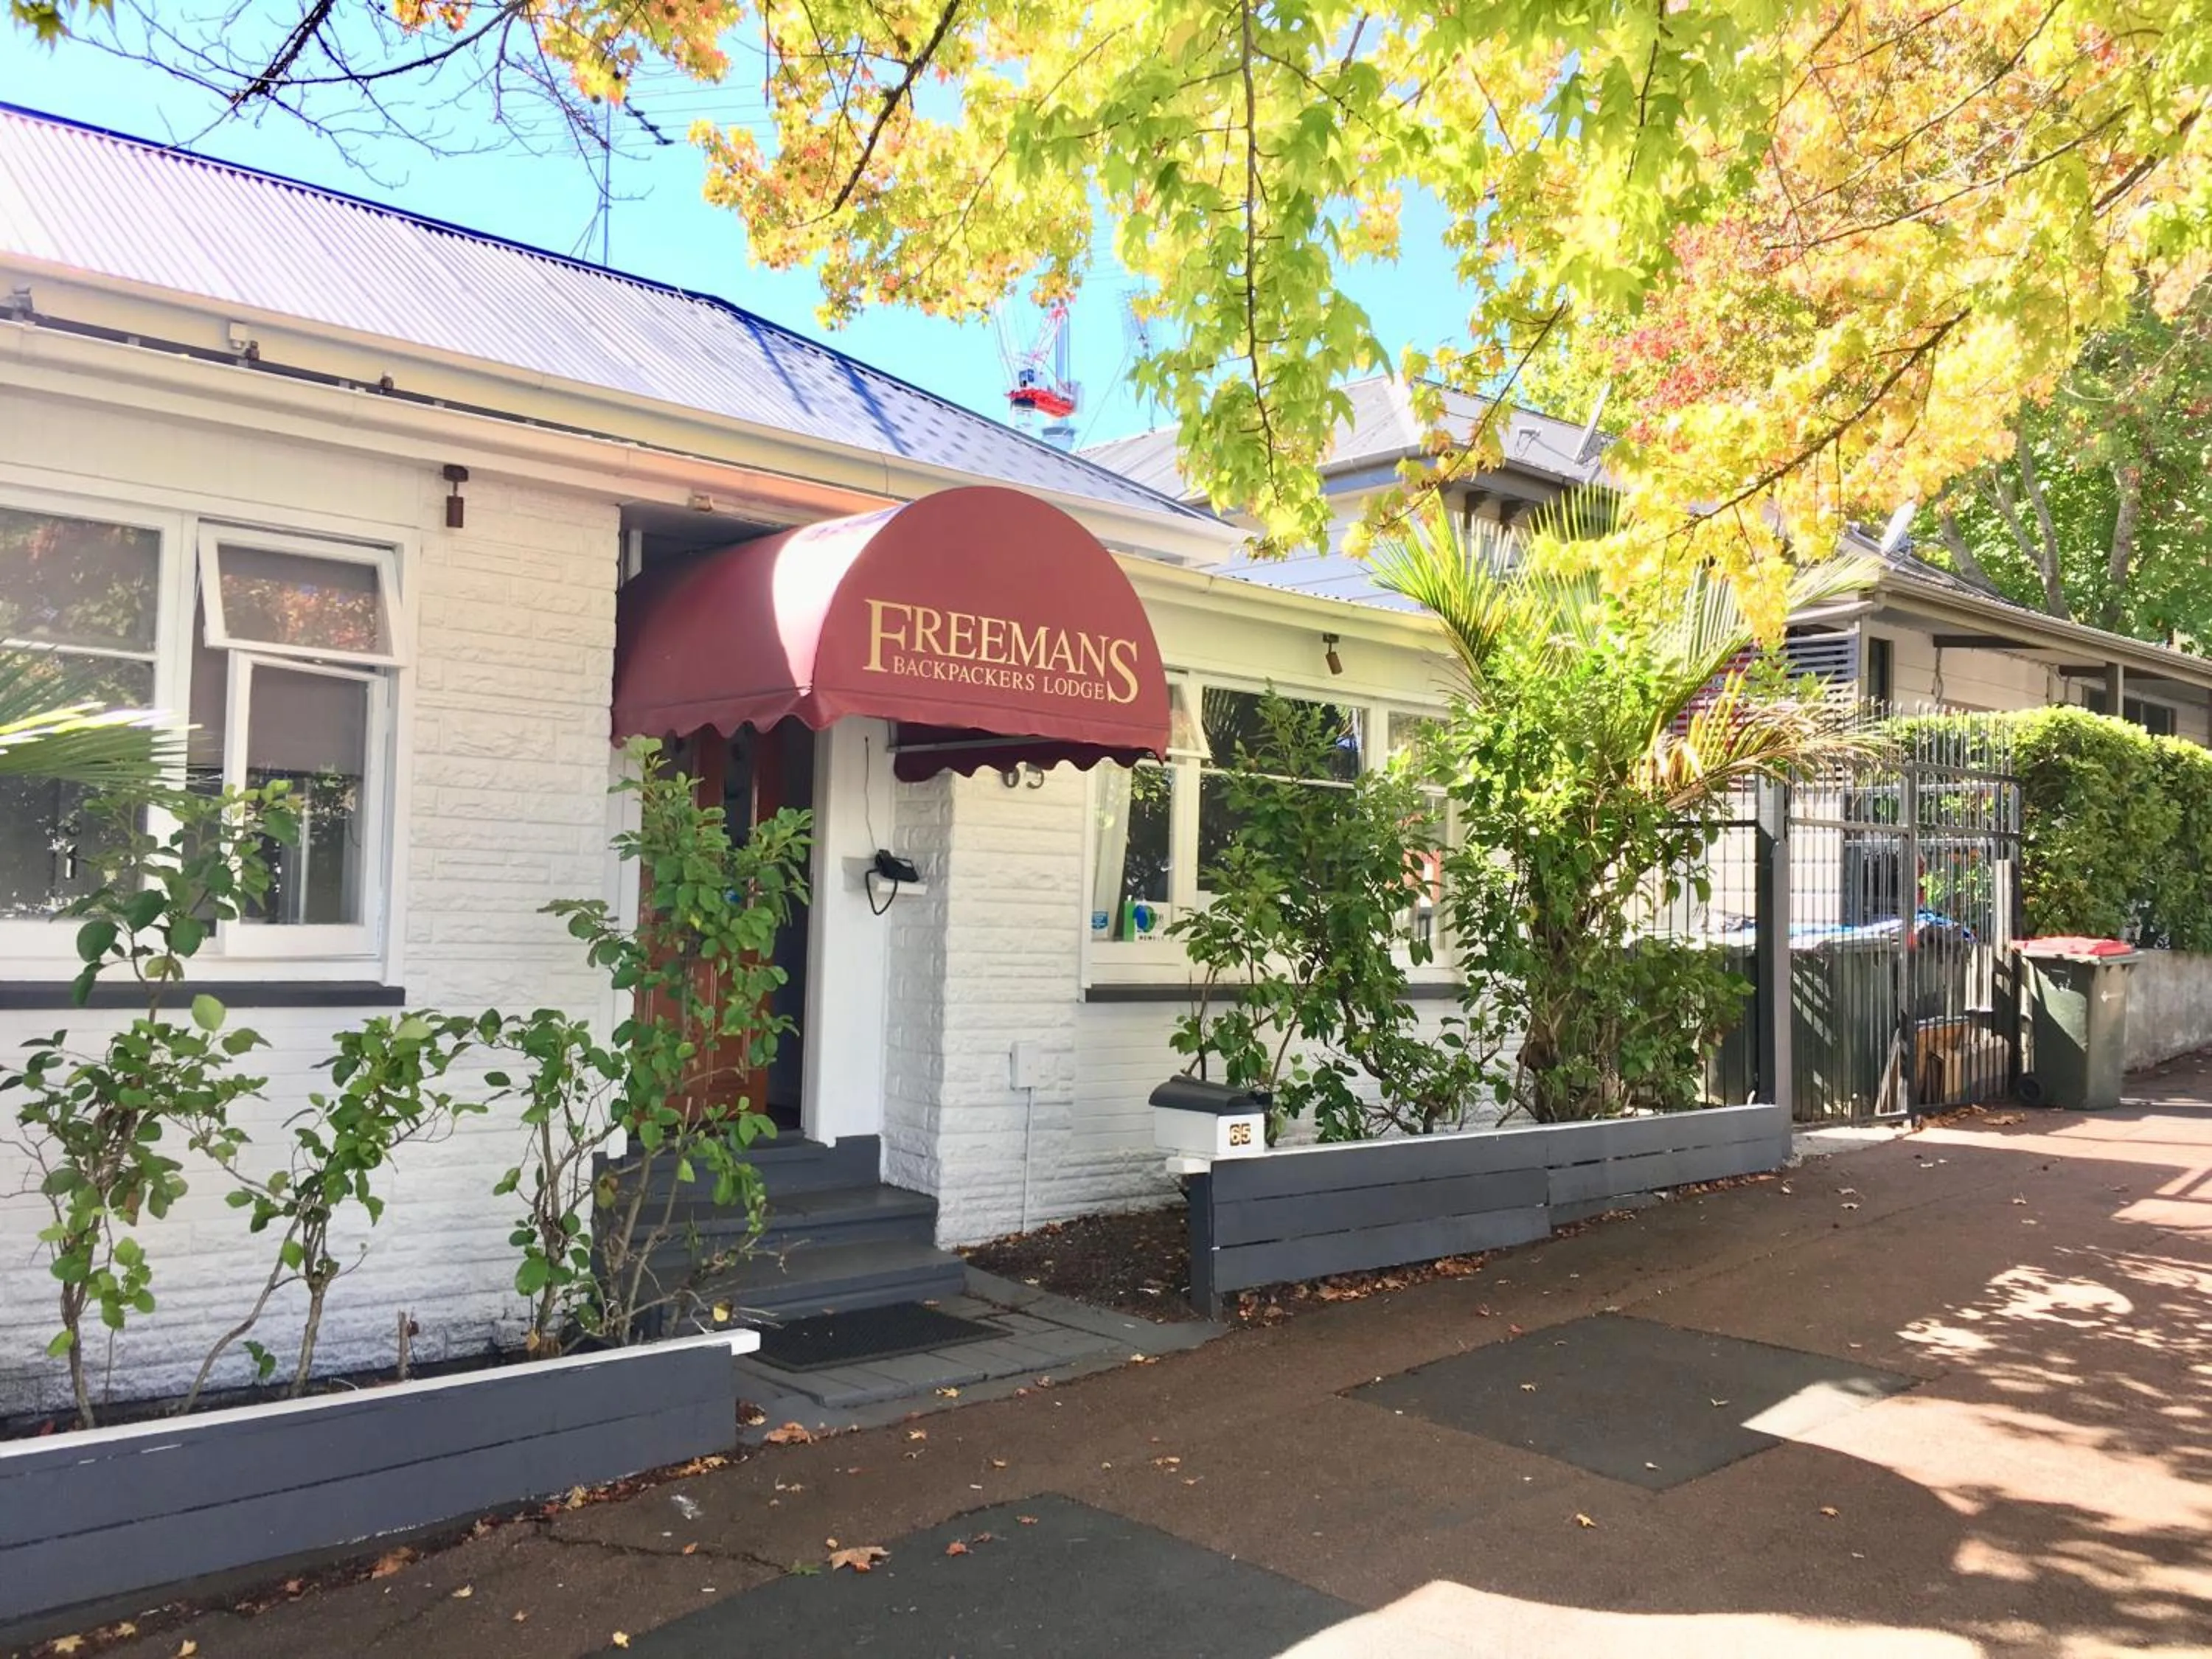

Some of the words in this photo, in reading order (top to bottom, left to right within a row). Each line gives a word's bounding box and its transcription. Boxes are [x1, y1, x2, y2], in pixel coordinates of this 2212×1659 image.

[863, 599, 1138, 703] FREEMANS
[892, 655, 1035, 691] BACKPACKERS
[1043, 676, 1105, 700] LODGE
[1229, 1122, 1251, 1147] 65
